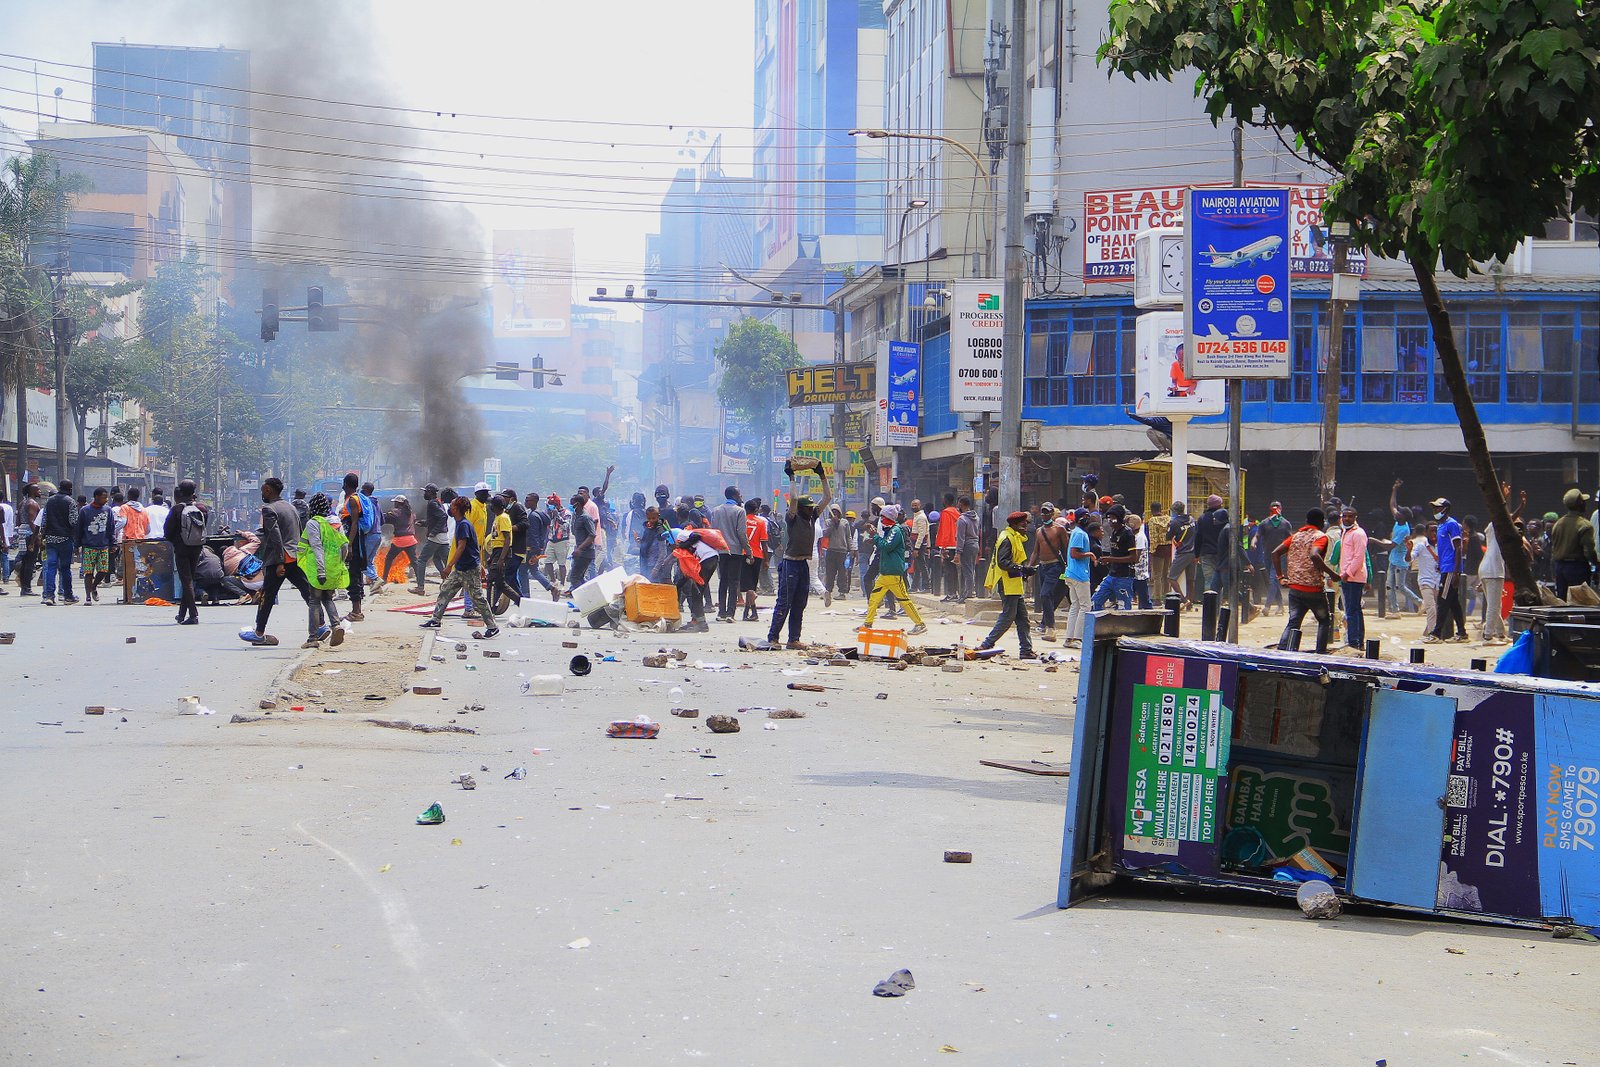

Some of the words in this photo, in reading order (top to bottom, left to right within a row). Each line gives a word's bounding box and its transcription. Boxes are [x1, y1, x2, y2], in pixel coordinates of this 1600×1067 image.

[1202, 197, 1238, 208] NAIROBI
[1240, 197, 1280, 208] AVIATION
[1087, 214, 1142, 232] POINT
[1088, 235, 1101, 244] OF
[1101, 234, 1136, 247] HAIR
[1294, 229, 1302, 242] &
[1292, 243, 1308, 256] TY
[1092, 266, 1115, 276] 0722
[960, 312, 1004, 320] PROGRESS
[972, 320, 1004, 328] CREDIT
[973, 349, 1002, 358] LOANS
[1198, 342, 1230, 354] 0724
[1232, 342, 1258, 353] 536
[1261, 342, 1286, 353] 048
[958, 368, 980, 378] 0700
[982, 368, 998, 378] 600
[804, 392, 846, 402] DRIVING
[746, 526, 757, 540] 7
[1156, 668, 1164, 686] ARD
[1166, 662, 1174, 684] HERE
[1138, 703, 1147, 744] Safaricom
[1458, 730, 1467, 752] BILL:
[1457, 754, 1465, 771] PAY
[1157, 770, 1167, 792] HERE
[1205, 778, 1214, 803] HERE
[1548, 764, 1562, 804] NOW
[1169, 773, 1178, 822] REPLACEMENT
[1180, 775, 1190, 815] AVAILABLE
[1234, 776, 1252, 824] BAMBA
[1250, 785, 1266, 822] HAPA
[1514, 752, 1529, 844] www.sportpesa.co.ke
[1562, 781, 1575, 819] GAME
[1154, 793, 1166, 838] AVAILABLE
[1204, 806, 1212, 819] UP
[1573, 767, 1600, 851] 79079
[1203, 821, 1211, 840] TOP
[1452, 814, 1462, 836] BILL:
[1544, 806, 1559, 848] PLAY
[1559, 822, 1571, 850] SMS
[1451, 838, 1460, 855] PAY
